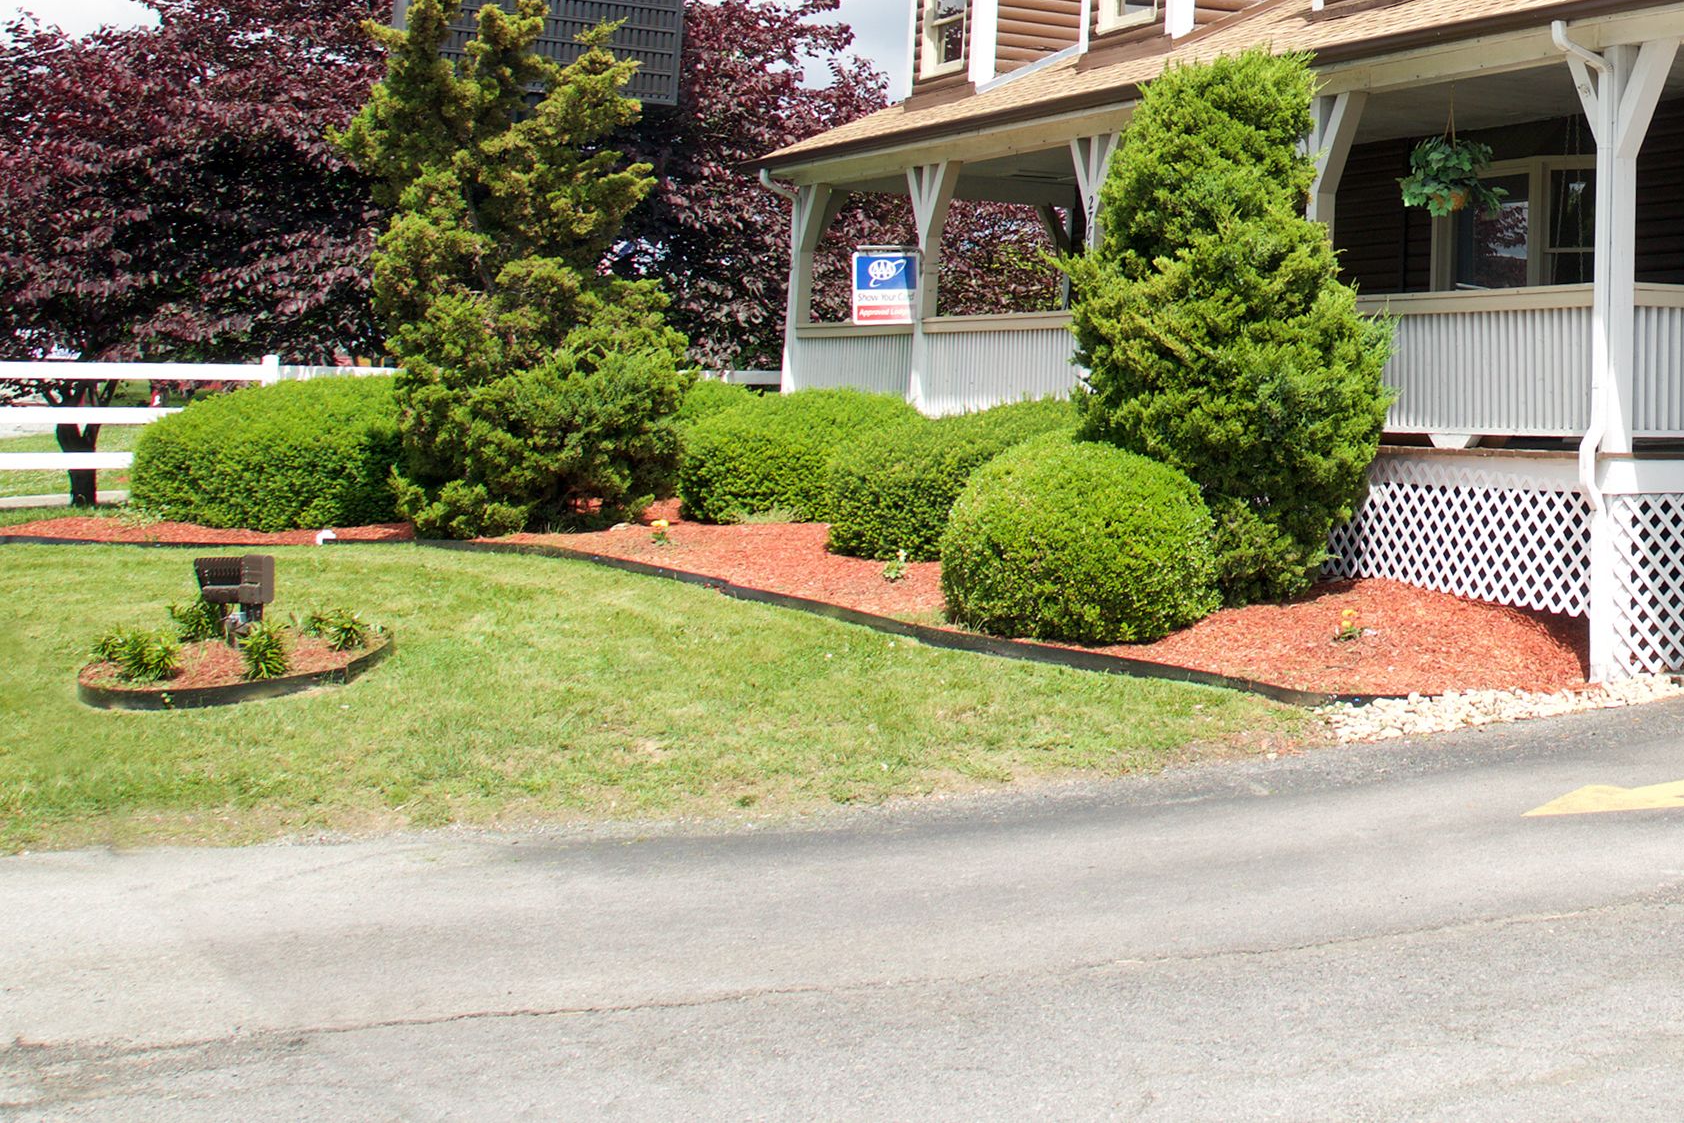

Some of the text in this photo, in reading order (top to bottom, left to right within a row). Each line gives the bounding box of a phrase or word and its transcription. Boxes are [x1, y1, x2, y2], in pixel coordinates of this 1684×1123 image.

[857, 292, 878, 302] Show
[881, 292, 896, 301] Your
[859, 308, 889, 318] Approved
